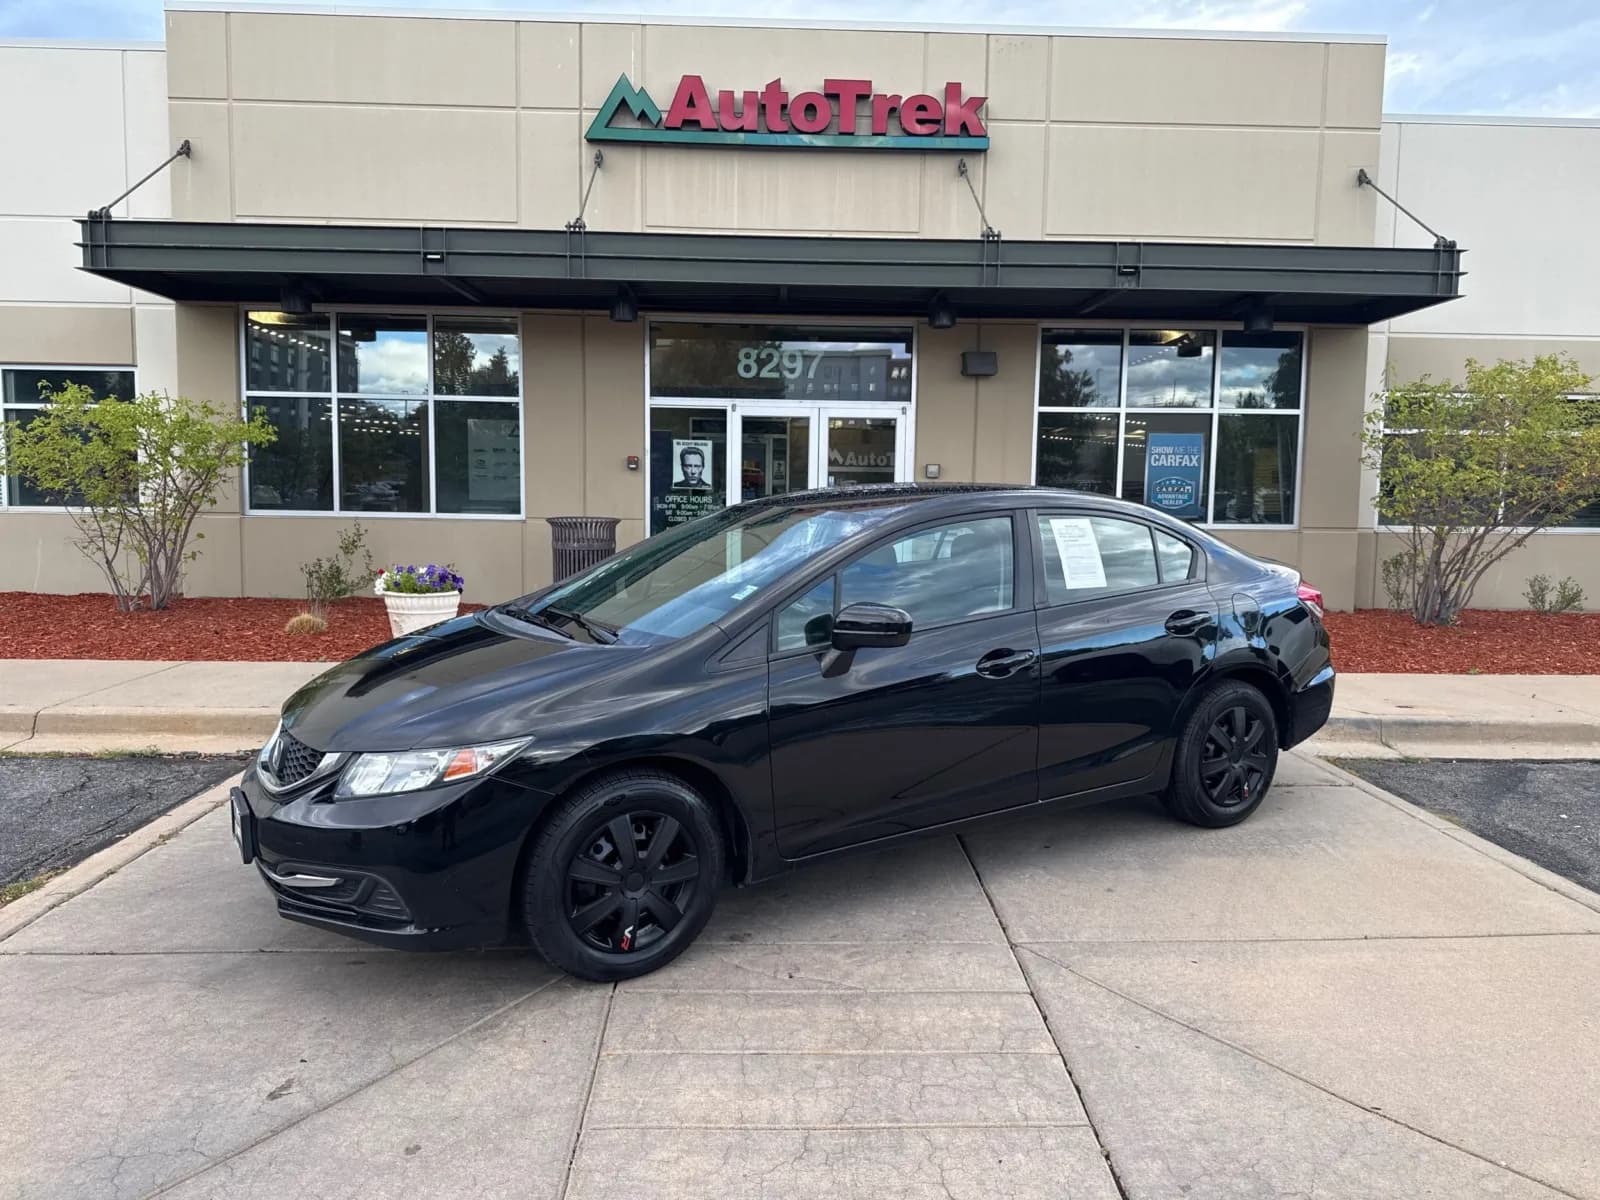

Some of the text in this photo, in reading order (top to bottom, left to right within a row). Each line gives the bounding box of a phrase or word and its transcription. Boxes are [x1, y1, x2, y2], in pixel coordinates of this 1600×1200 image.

[664, 74, 988, 137] AutoTrek
[737, 347, 824, 379] 8297
[1151, 446, 1200, 454] SHOW ME THE
[1151, 454, 1199, 467] CARFAX
[690, 496, 713, 504] HOURS
